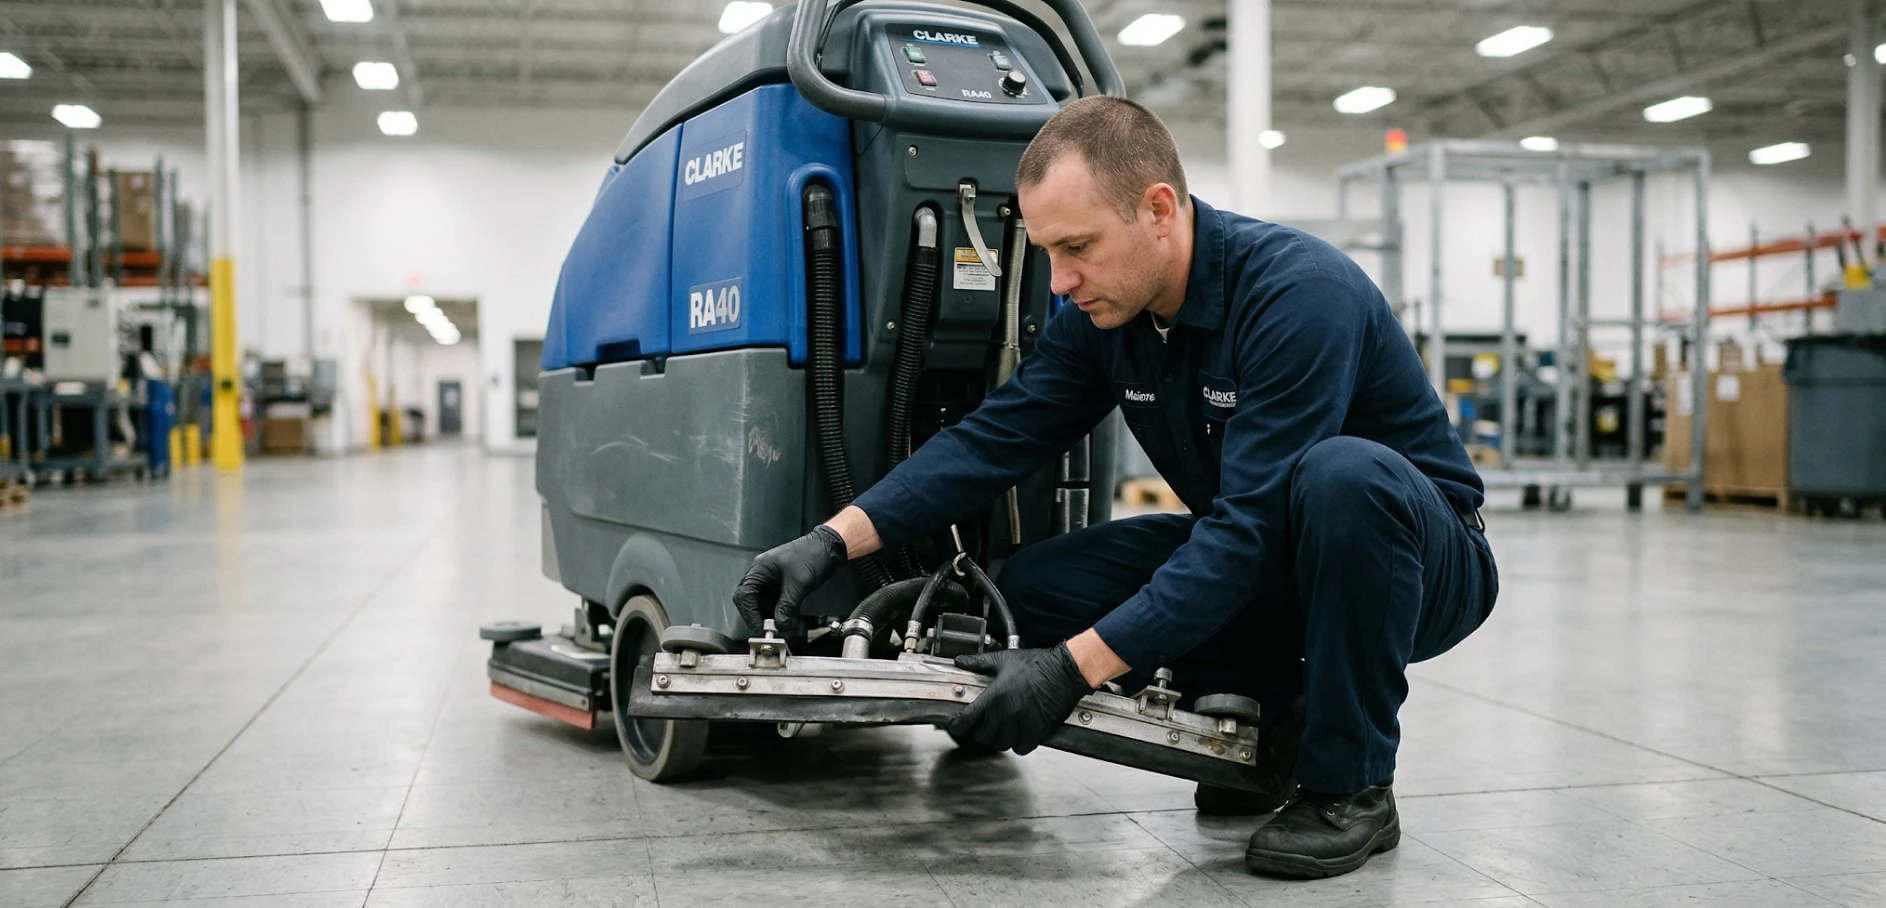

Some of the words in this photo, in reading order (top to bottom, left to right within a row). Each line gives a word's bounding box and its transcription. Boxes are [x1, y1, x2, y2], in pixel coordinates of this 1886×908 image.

[913, 30, 978, 45] CLARKE
[961, 89, 992, 99] RA40
[685, 142, 744, 185] CLARKE
[690, 285, 740, 328] RA40
[1203, 386, 1237, 402] CLARKE
